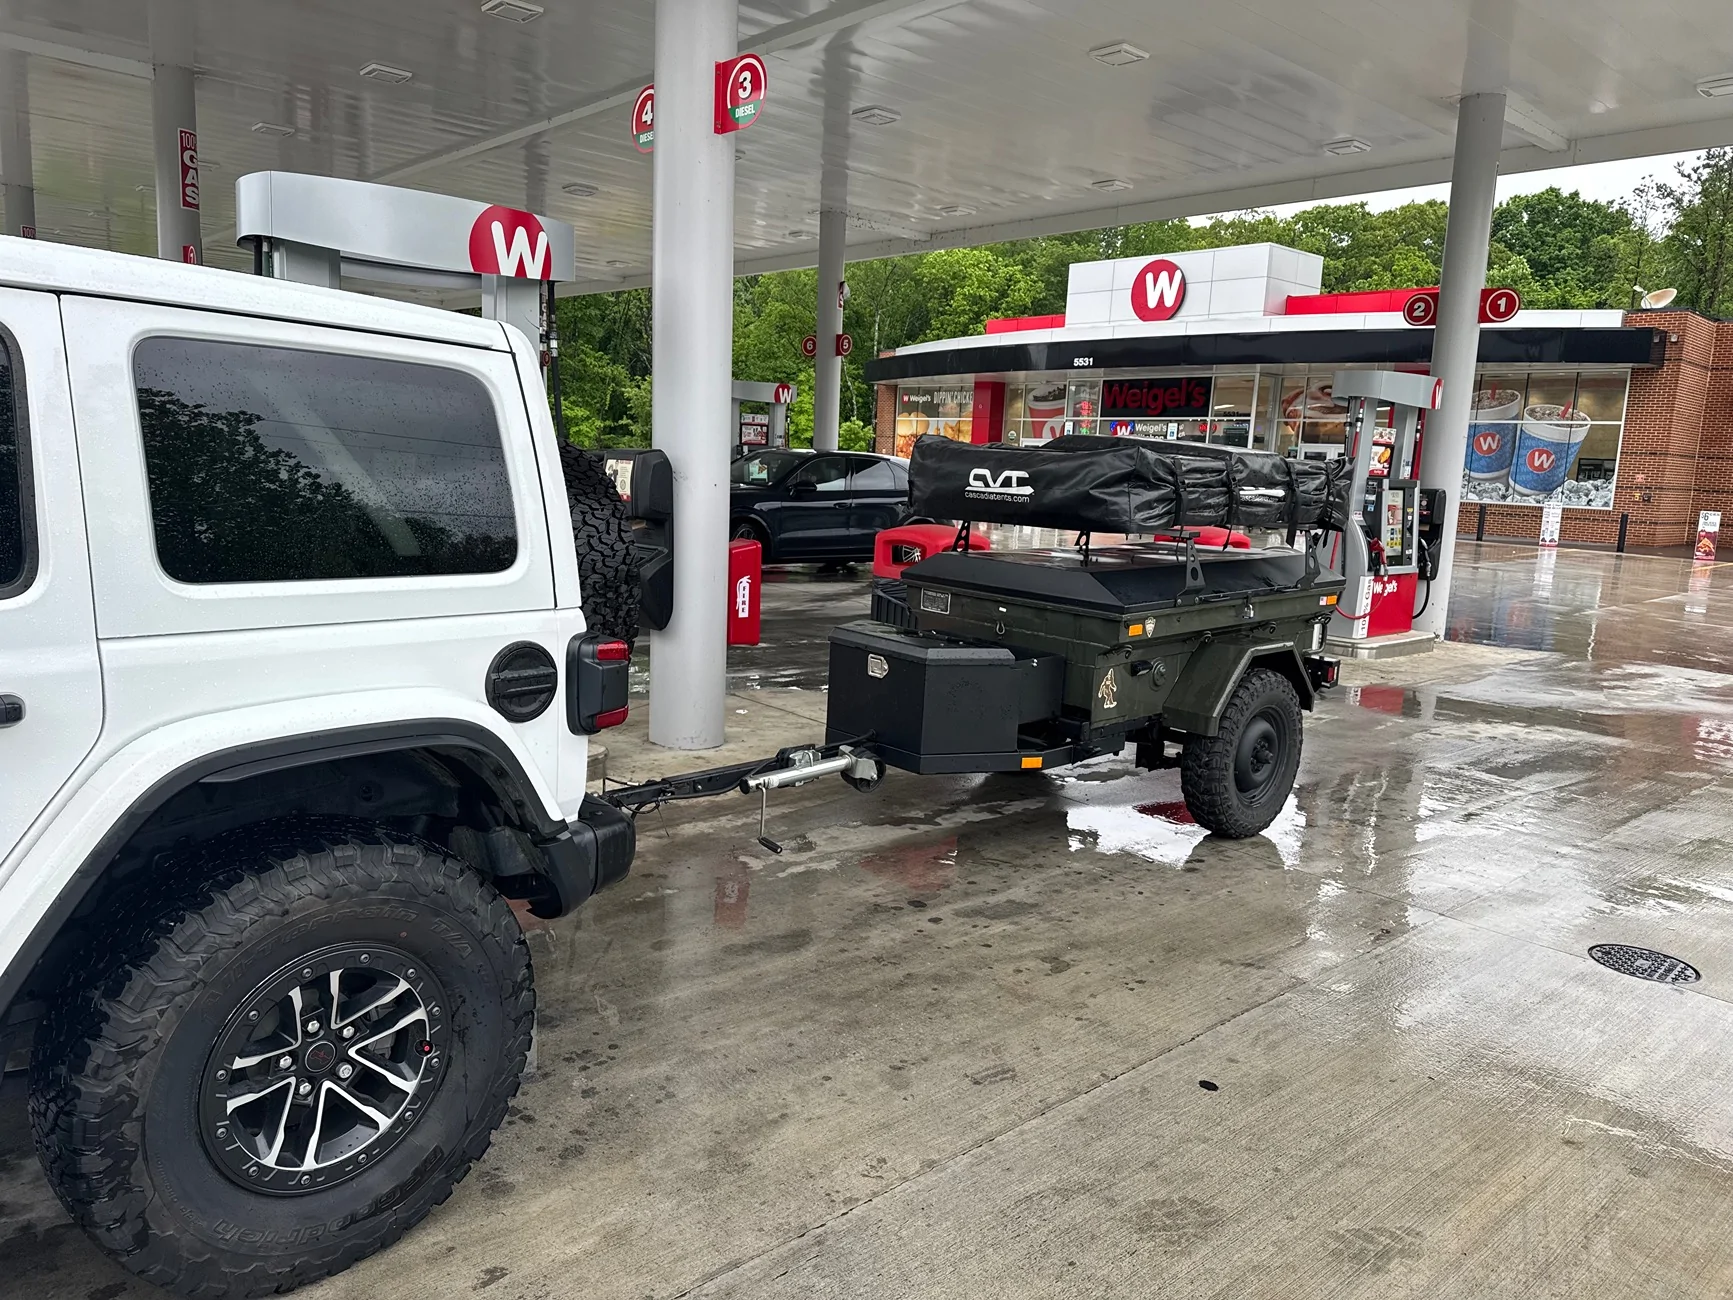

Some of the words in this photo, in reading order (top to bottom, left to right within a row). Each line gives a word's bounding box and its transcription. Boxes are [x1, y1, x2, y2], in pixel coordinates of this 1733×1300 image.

[737, 70, 752, 99] 3
[641, 100, 653, 125] 4
[735, 103, 755, 118] DIESEL
[640, 131, 654, 143] DIESE
[183, 149, 199, 205] GAS
[491, 220, 548, 280] W
[1145, 269, 1183, 309] W
[1412, 302, 1426, 317] 2
[1497, 297, 1507, 312] 1
[806, 340, 813, 350] 6
[843, 339, 849, 349] 5
[1073, 357, 1094, 366] 5531
[779, 388, 792, 403] W
[910, 394, 931, 403] Weigel's
[933, 391, 954, 404] DIPPIN'
[1104, 379, 1206, 416] Weigel's
[1116, 425, 1130, 436] W
[1135, 423, 1167, 433] Weigel's
[1480, 434, 1500, 451] W
[1534, 451, 1555, 469] W
[968, 468, 1030, 488] CVT
[964, 491, 1030, 503] cascadiatents.com
[1373, 579, 1398, 597] Wegel's
[1360, 602, 1370, 632] 10%
